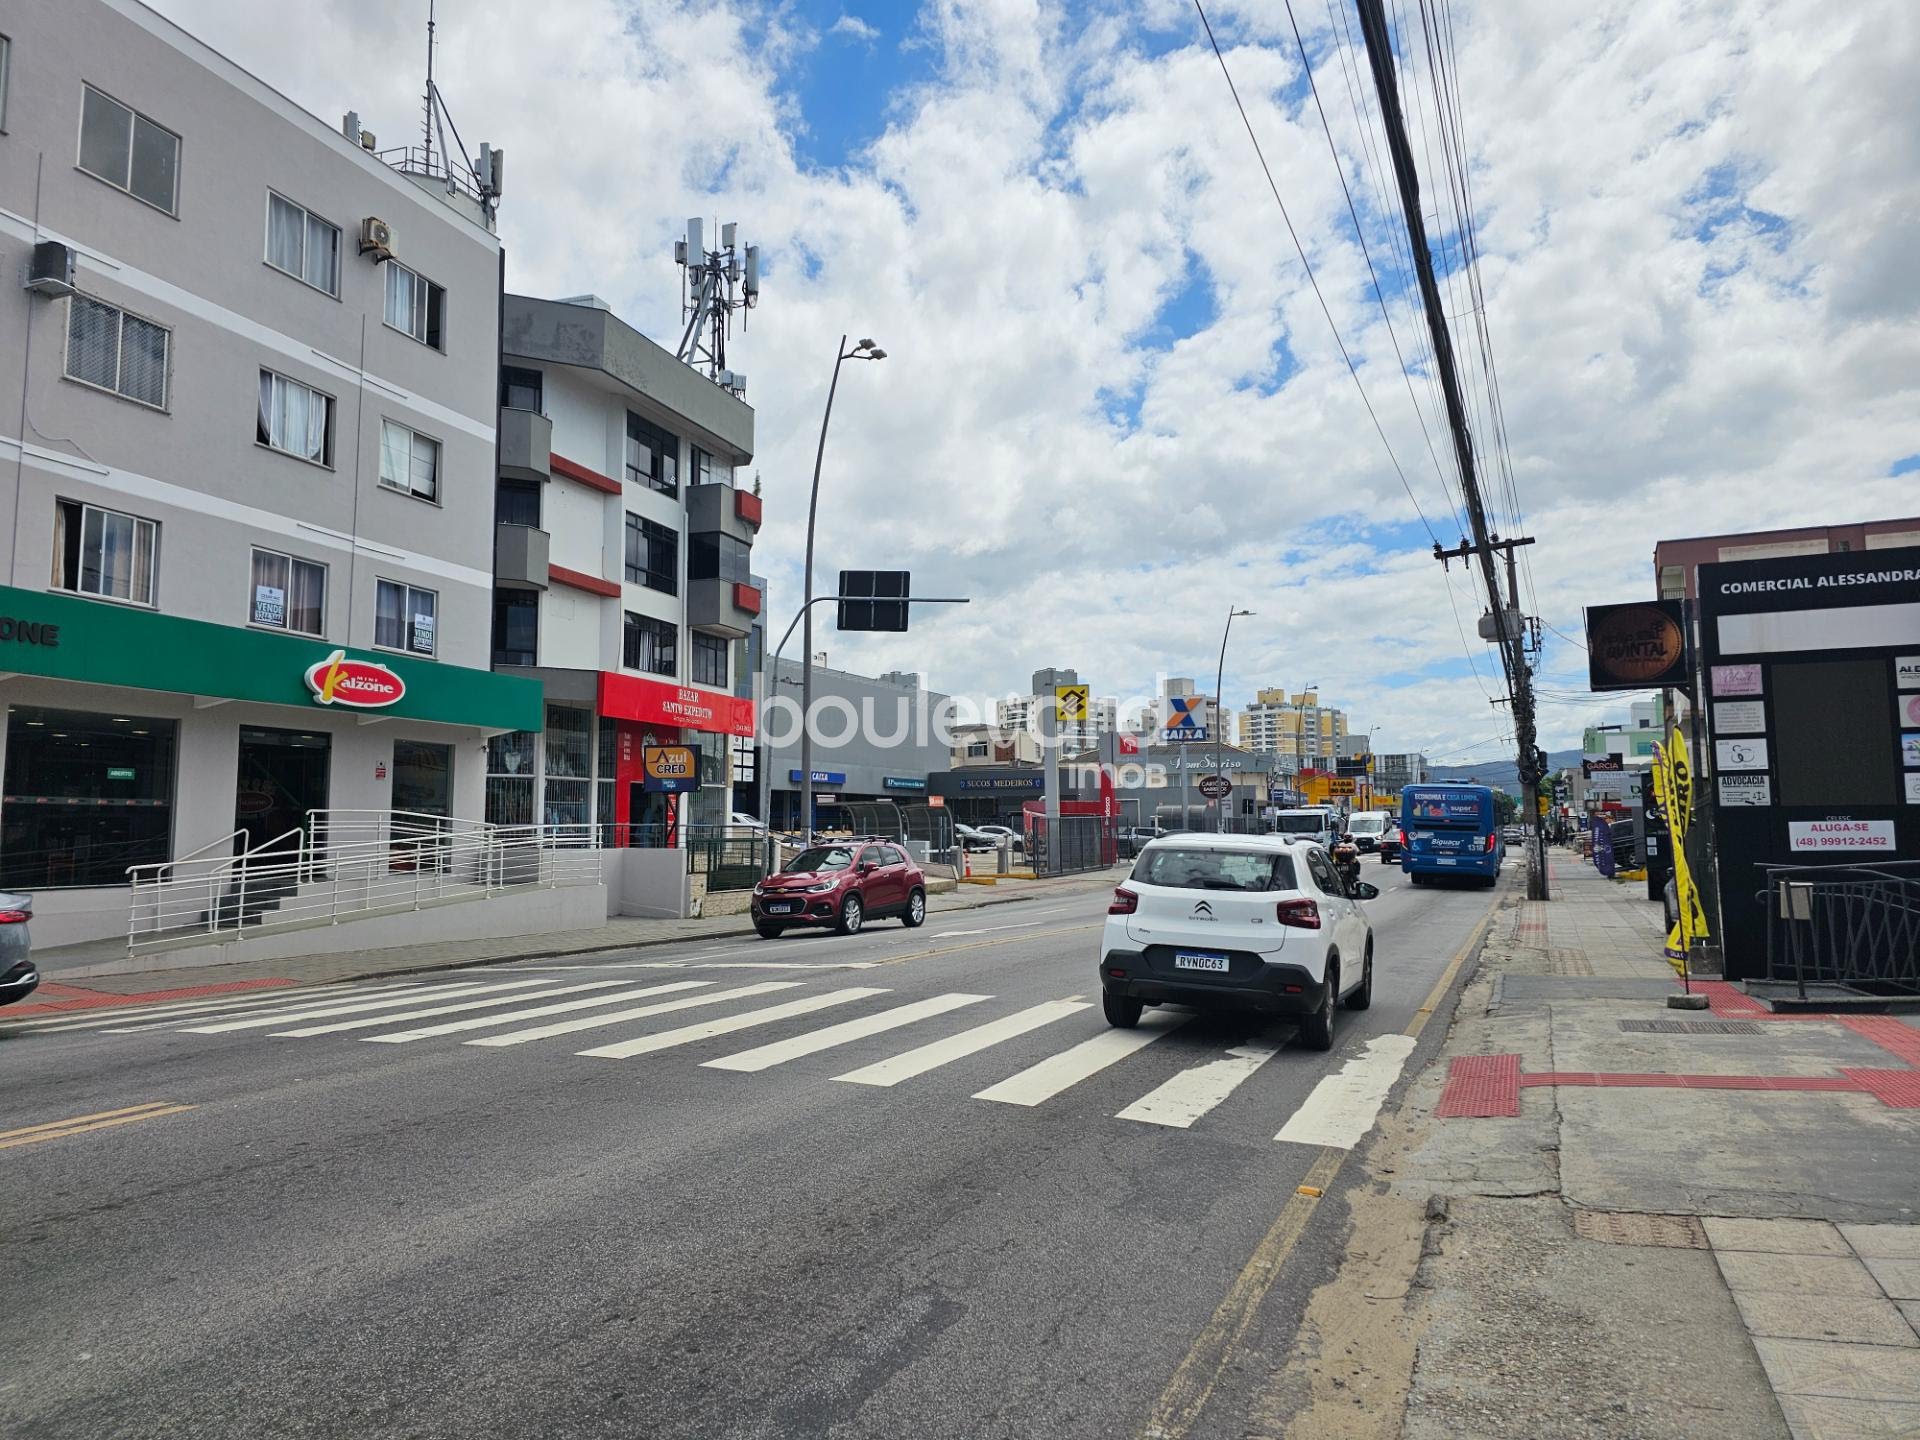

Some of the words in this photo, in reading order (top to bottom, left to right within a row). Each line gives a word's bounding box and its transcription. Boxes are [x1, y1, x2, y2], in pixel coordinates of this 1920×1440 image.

[1720, 577, 1813, 594] COMERCIAL
[257, 601, 283, 614] VENDE
[678, 688, 699, 703] BAZAR
[662, 701, 683, 714] SANTO
[683, 704, 713, 720] EXPEDITO
[1161, 729, 1204, 740] CAIXA
[648, 749, 687, 763] Azul
[656, 764, 687, 774] CRED
[993, 779, 1033, 787] MEDEIROS
[1721, 776, 1765, 785] ADVOCACIA
[1810, 823, 1869, 832] ALUGA-SE
[1431, 838, 1460, 846] Biguaçu
[1795, 838, 1817, 848] (48)
[1820, 837, 1887, 846] 99912-2452
